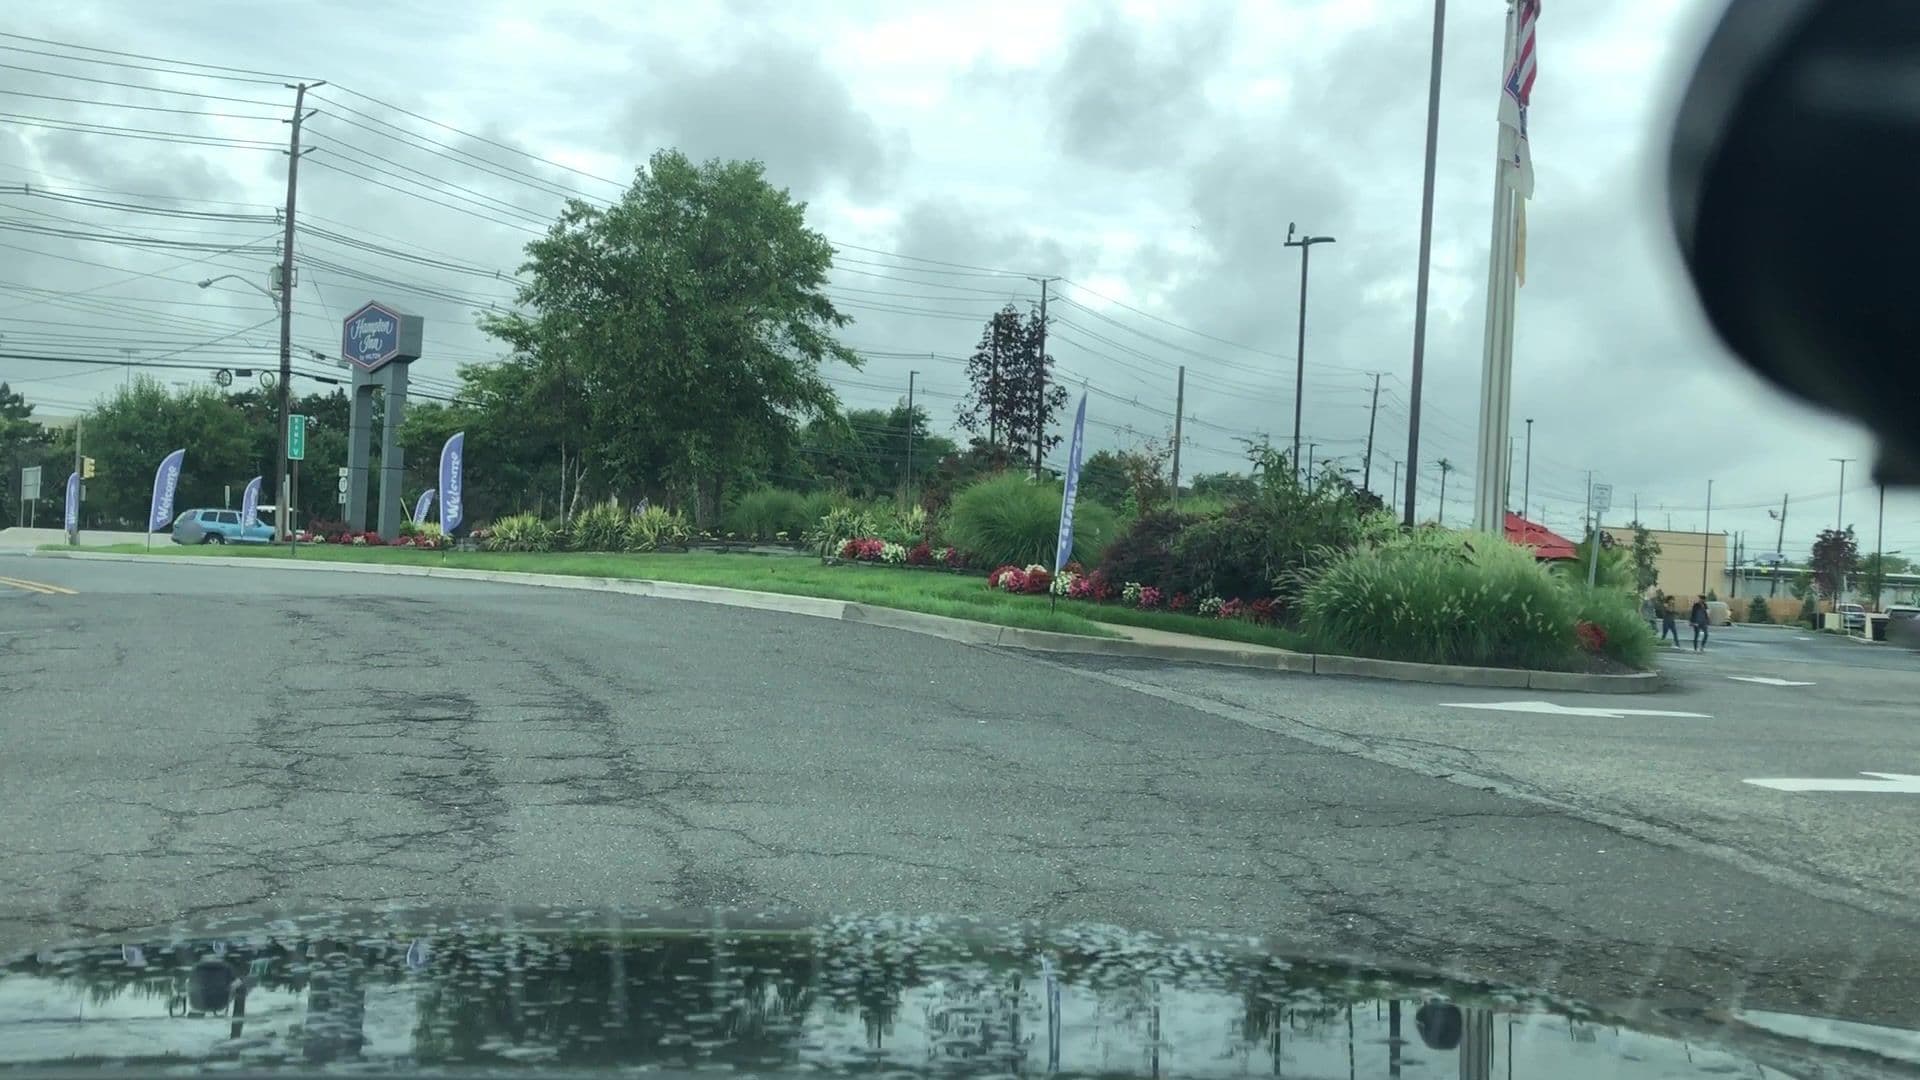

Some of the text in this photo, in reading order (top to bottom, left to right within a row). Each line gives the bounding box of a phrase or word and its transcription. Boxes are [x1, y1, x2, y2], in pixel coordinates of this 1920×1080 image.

[350, 318, 393, 340] Hampton
[358, 334, 383, 353] Inn
[156, 465, 177, 523] Welcome
[446, 451, 461, 522] Welcome
